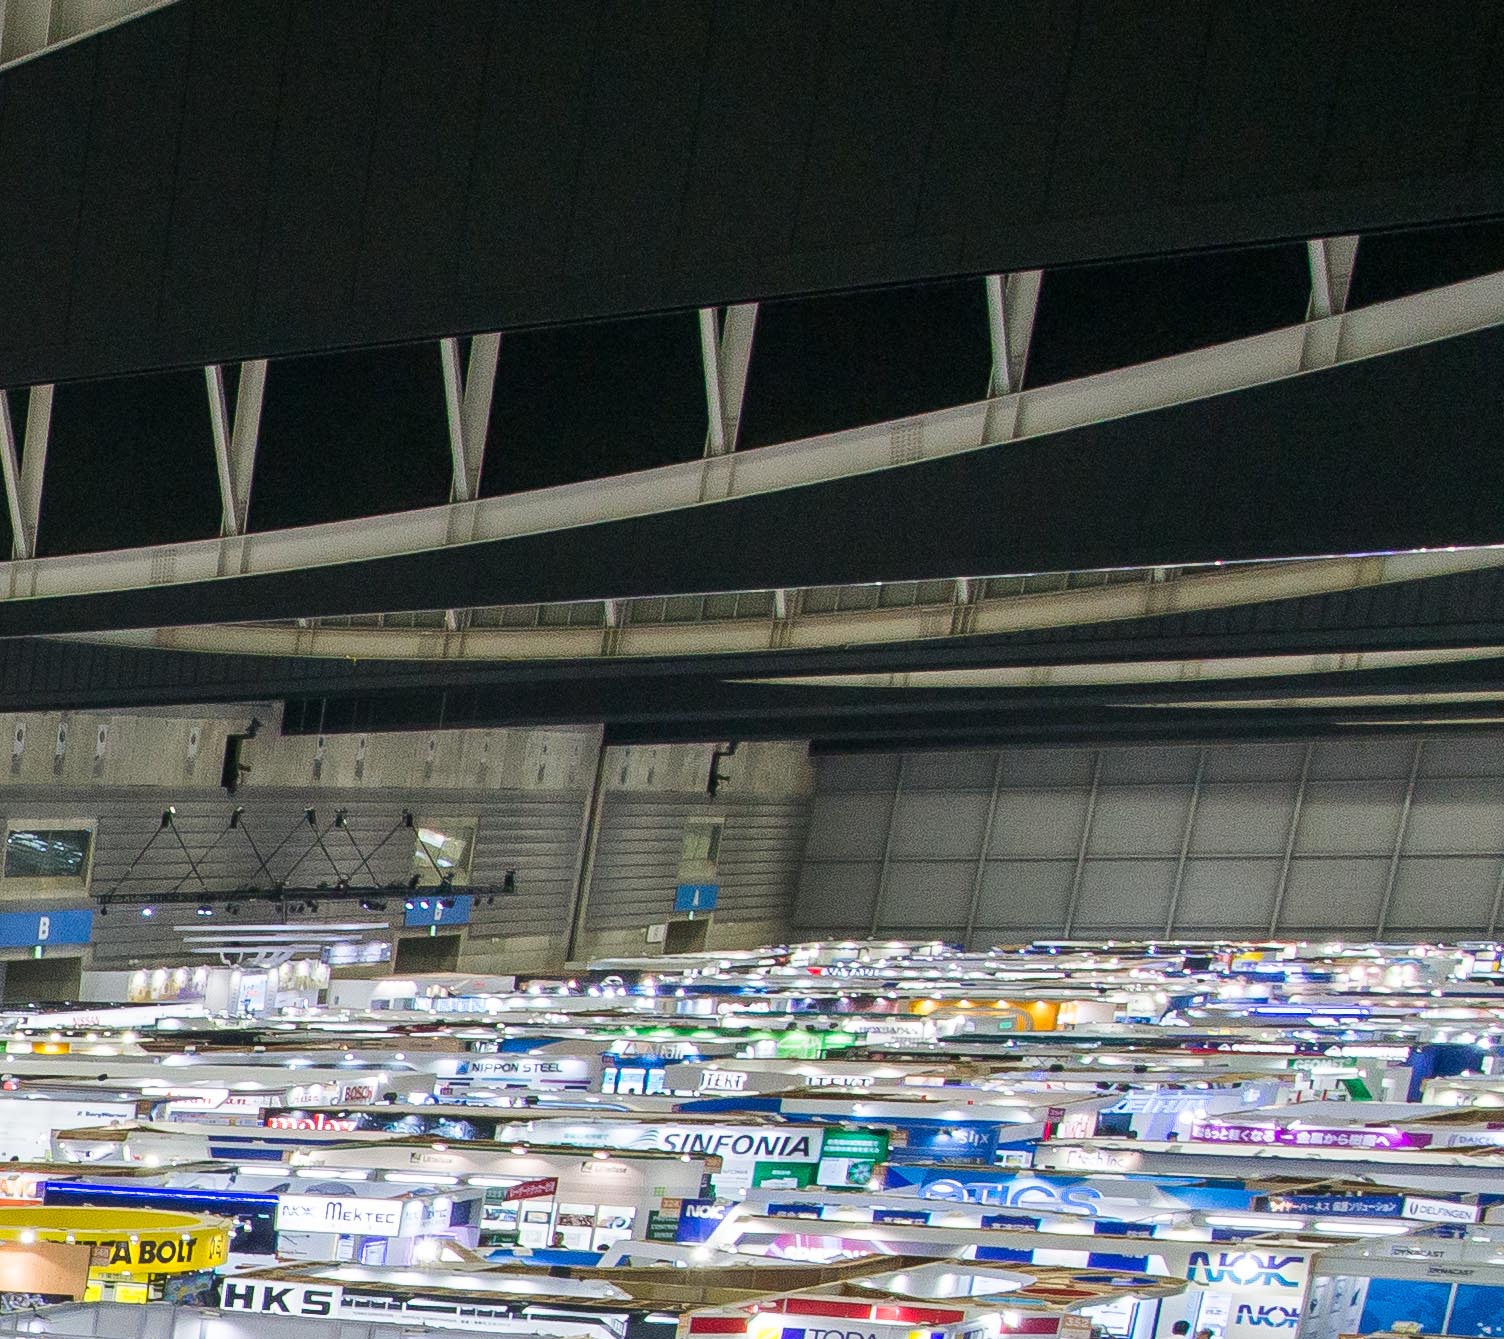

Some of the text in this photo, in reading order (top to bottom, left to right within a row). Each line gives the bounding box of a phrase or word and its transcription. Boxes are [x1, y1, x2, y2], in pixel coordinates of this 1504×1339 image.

[38, 916, 49, 940] B
[470, 1062, 563, 1074] NIPPON STEEL
[663, 1132, 810, 1157] SINFONIA
[685, 1205, 726, 1220] NOK
[138, 1237, 197, 1265] BOLT
[1185, 1252, 1304, 1288] NOK
[223, 1284, 334, 1317] HKS
[1236, 1303, 1298, 1328] NOK
